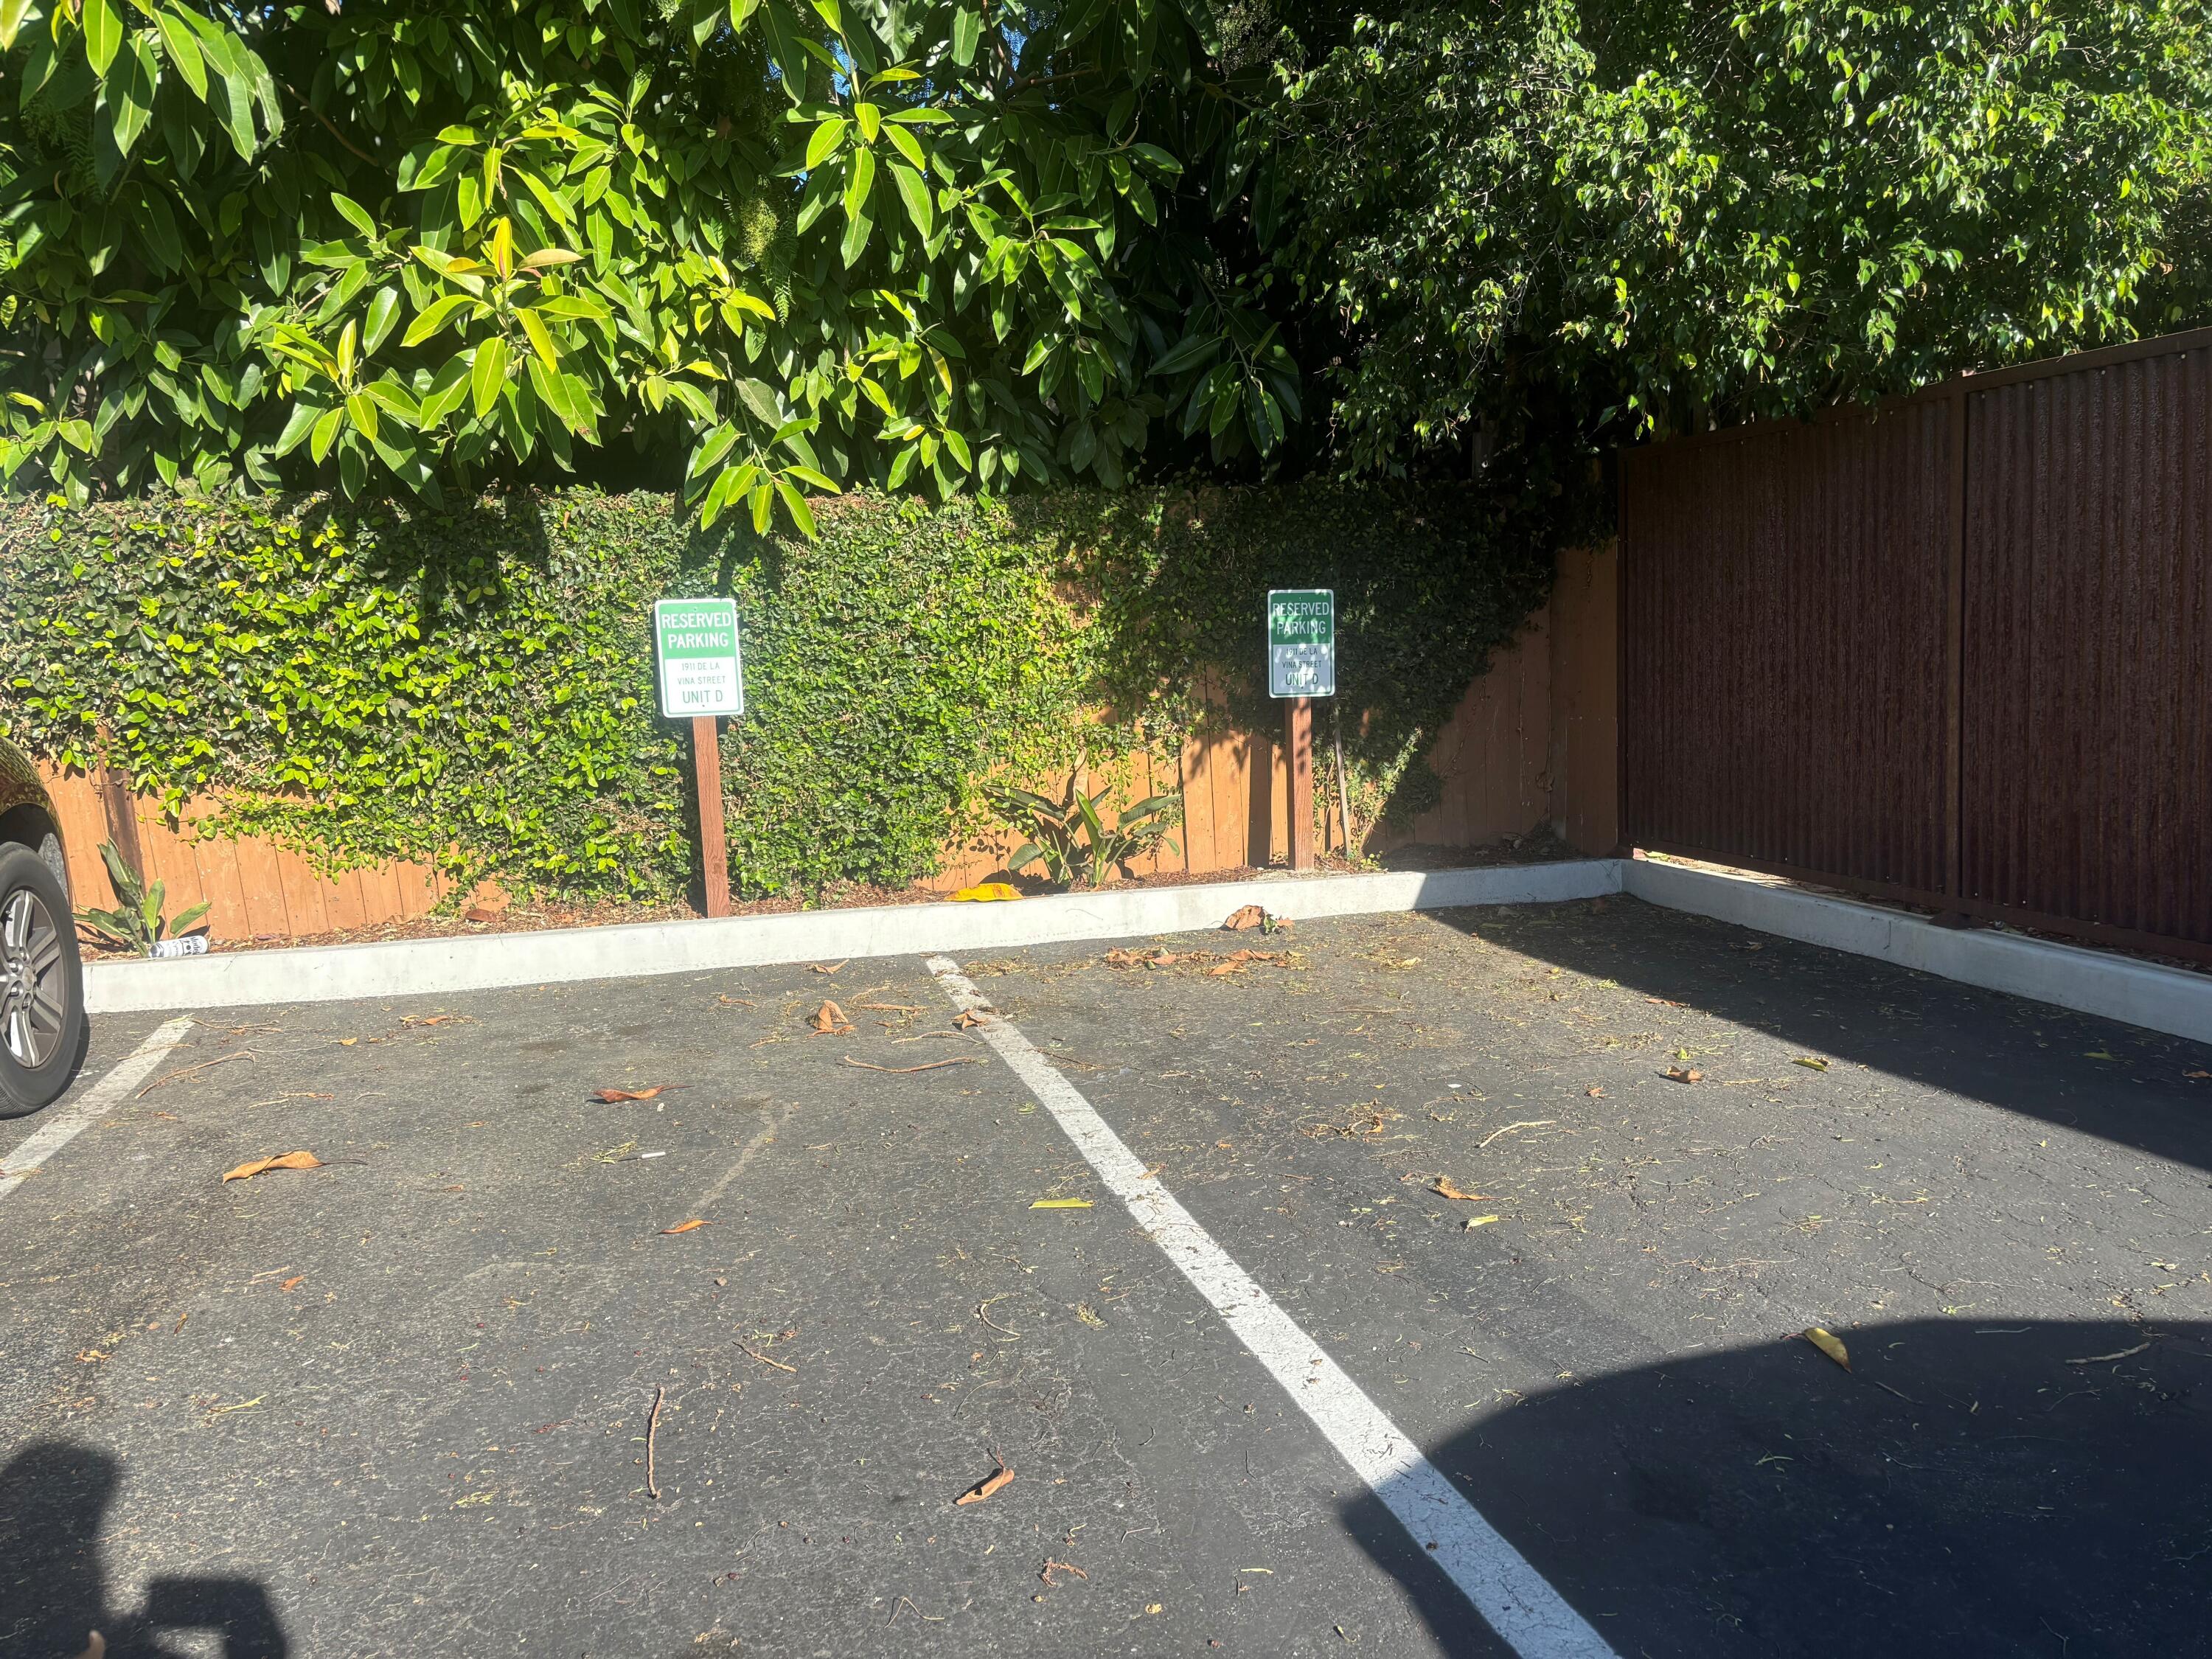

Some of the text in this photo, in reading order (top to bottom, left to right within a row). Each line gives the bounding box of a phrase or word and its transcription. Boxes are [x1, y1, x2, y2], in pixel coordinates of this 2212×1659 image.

[1273, 602, 1329, 616] RESERVED
[662, 612, 731, 628] RESERVED
[1278, 621, 1326, 634] PARKING
[669, 633, 728, 648] PARKING
[698, 662, 707, 670] DE
[710, 662, 720, 670] LA
[698, 675, 726, 685] STREET
[1286, 673, 1318, 685] UNIT D
[683, 690, 723, 703] UNIT D
